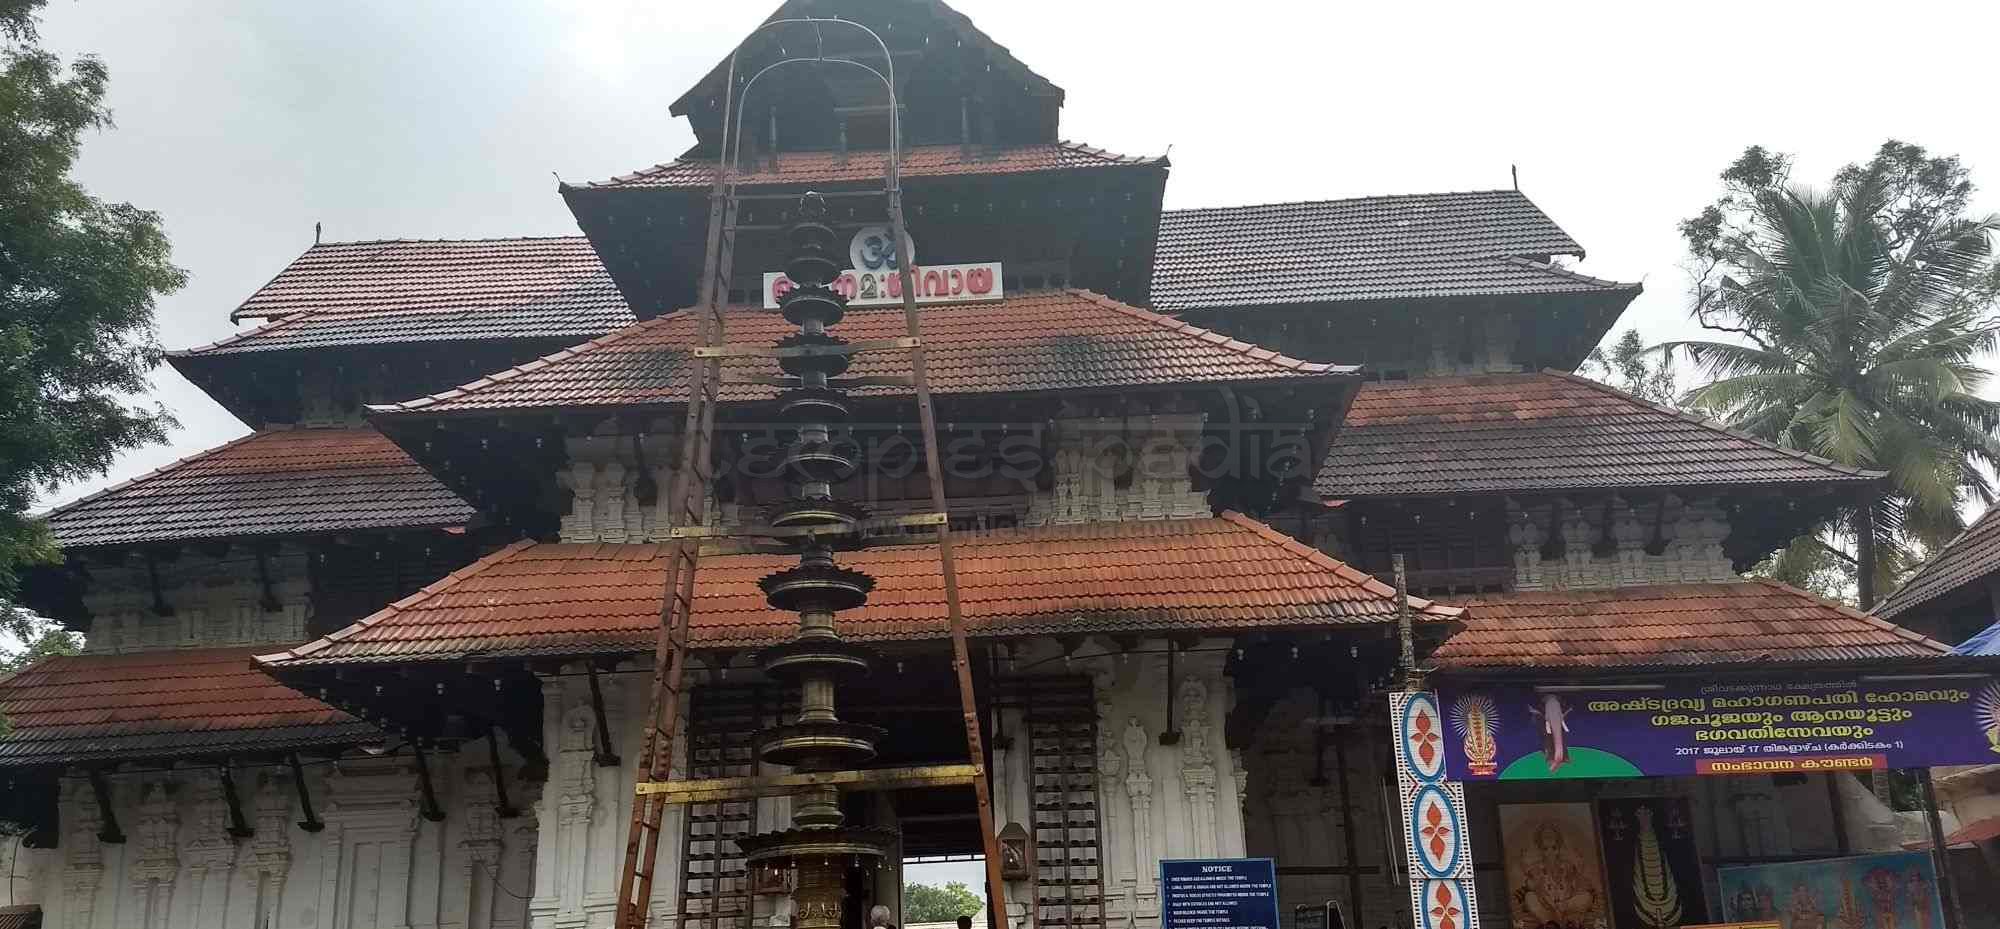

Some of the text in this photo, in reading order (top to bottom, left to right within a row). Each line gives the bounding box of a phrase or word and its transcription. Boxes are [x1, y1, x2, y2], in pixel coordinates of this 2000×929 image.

[1712, 691, 1859, 709] മഹാഗണപതി
[1865, 689, 1970, 703] ഹോമവും
[1651, 707, 1912, 727] ഗജപൂജയും ആനയൂട്ടും
[1695, 723, 1874, 741] ഭഗവതിസേവയും
[1675, 747, 1699, 755] 2017
[1748, 745, 1760, 754] 17
[1894, 740, 1904, 750] 1)
[1711, 759, 1795, 771] സംഭാവന
